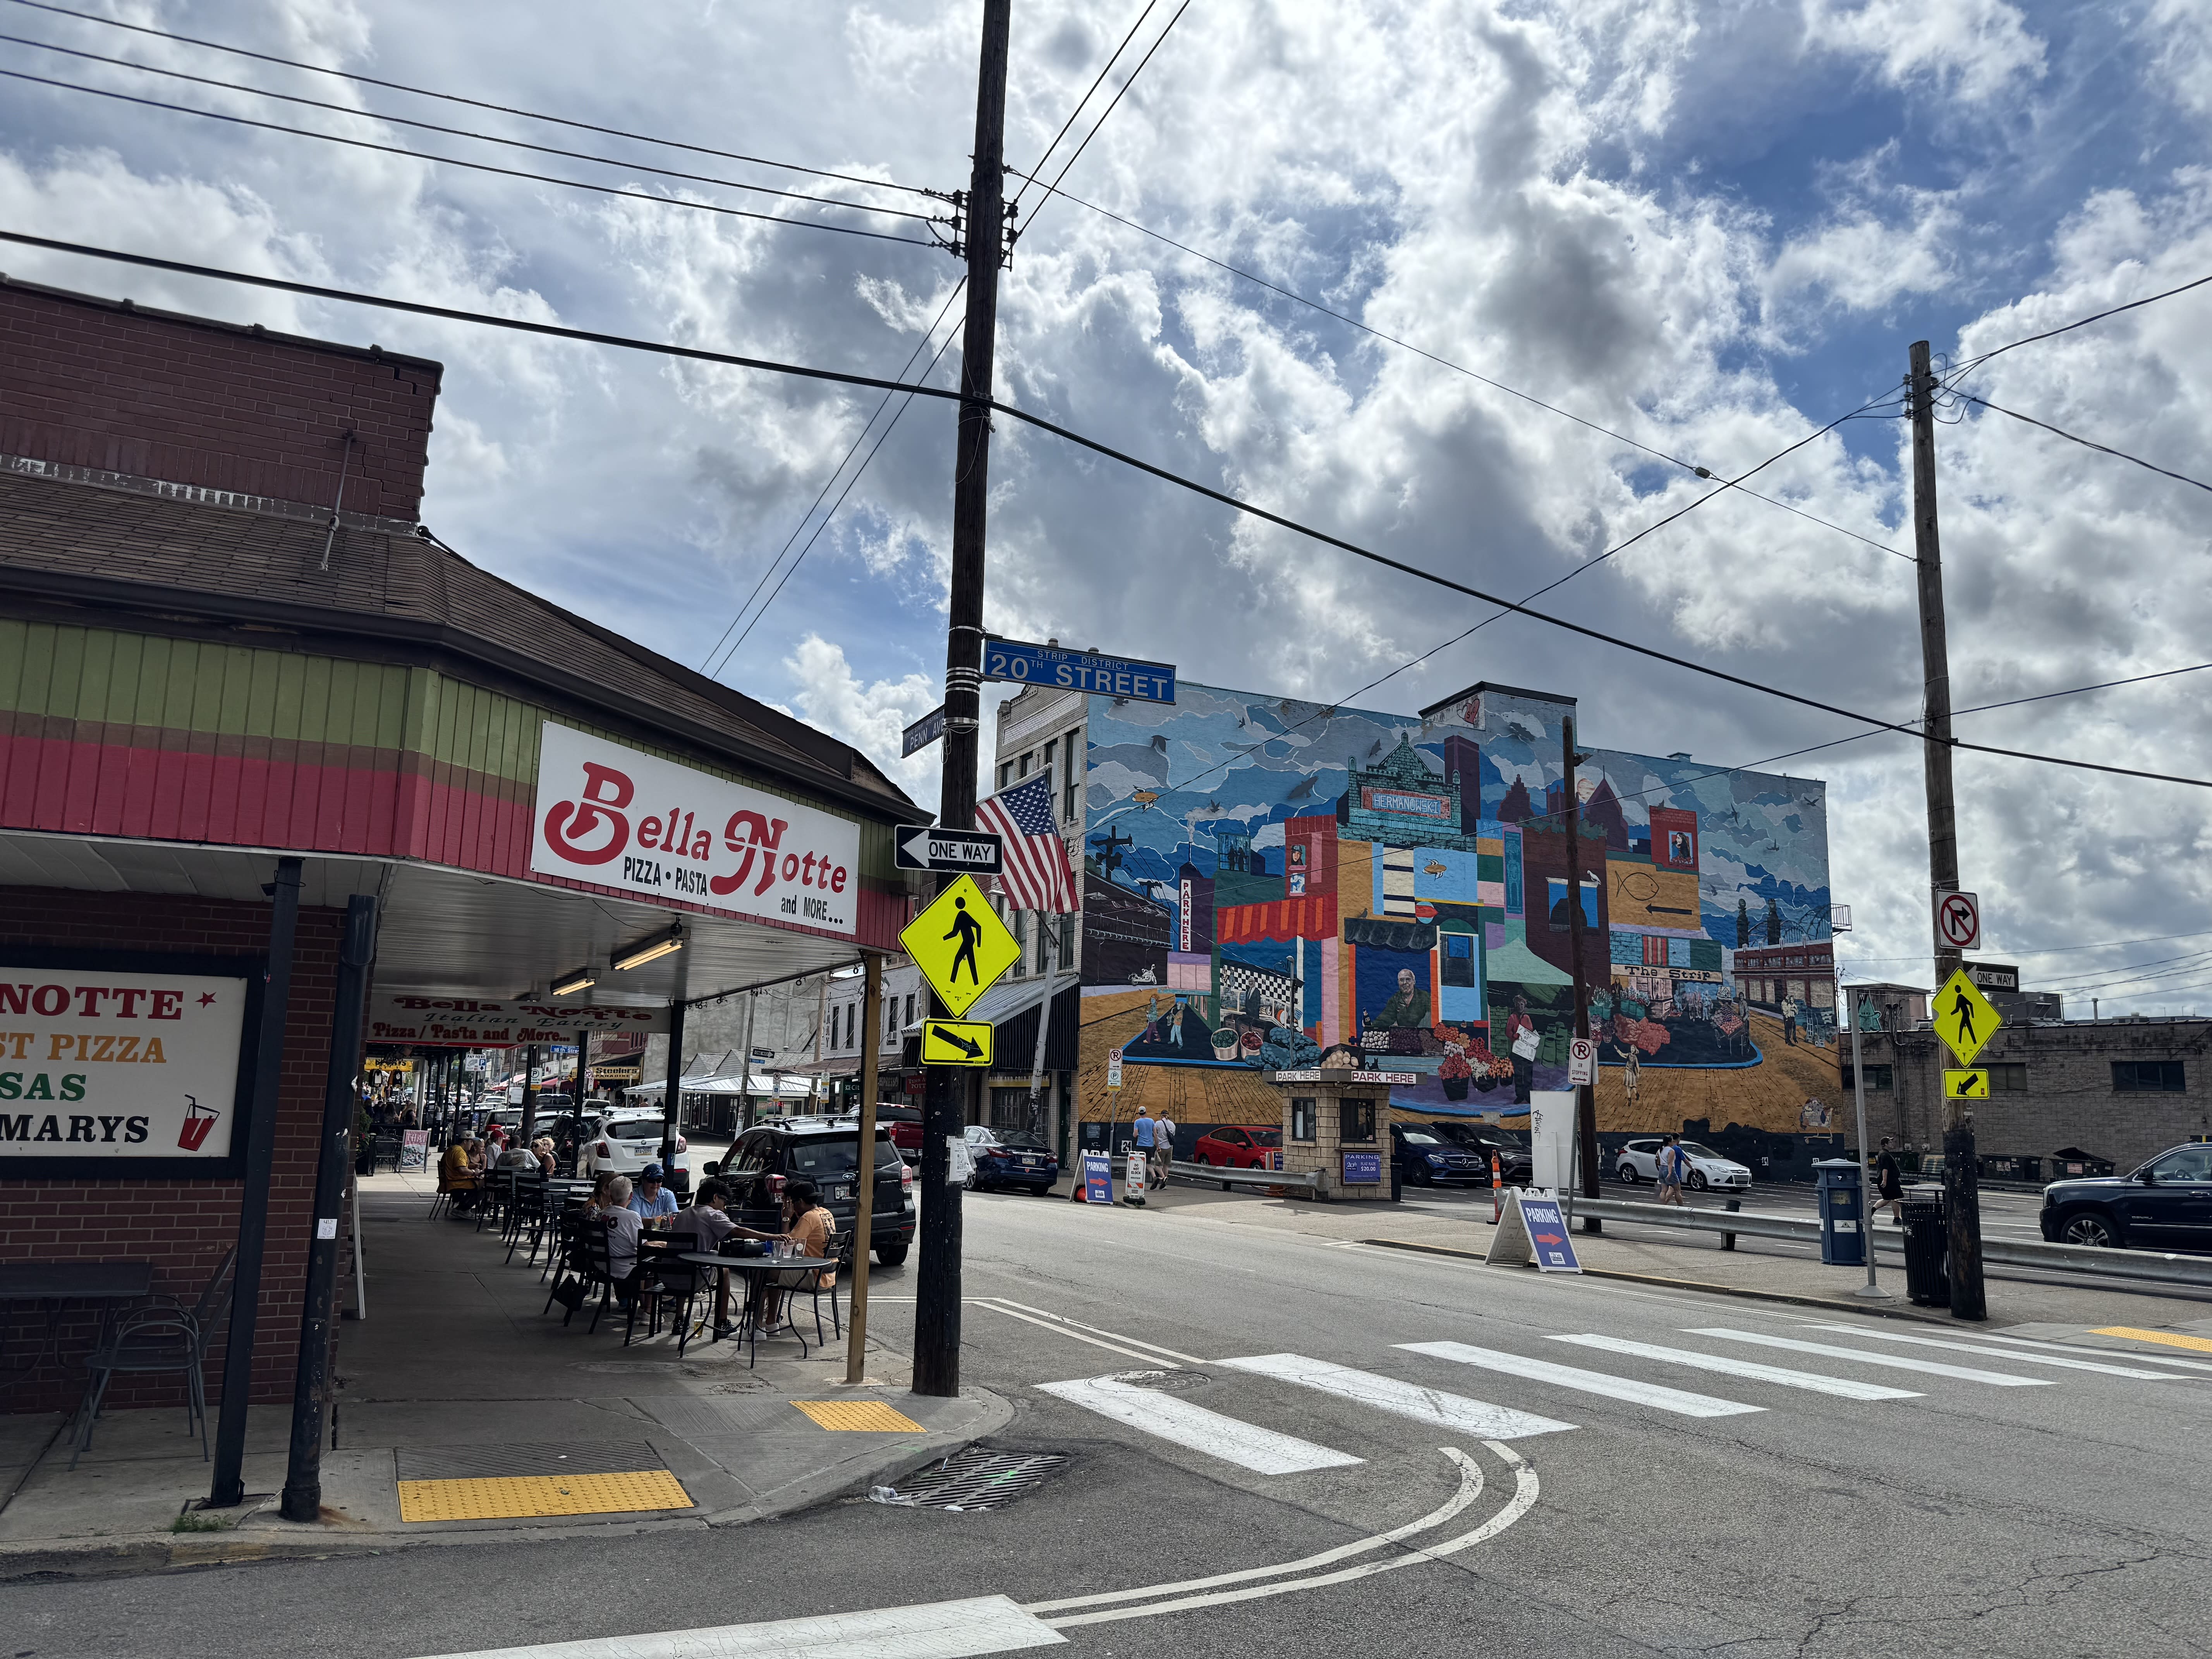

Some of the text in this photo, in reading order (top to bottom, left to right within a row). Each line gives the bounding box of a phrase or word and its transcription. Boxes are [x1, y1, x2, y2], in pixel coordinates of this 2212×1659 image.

[1037, 650, 1129, 671] STRIP DISTRICT
[991, 654, 1168, 699] 20TH STREET
[910, 728, 927, 750] PENN
[1374, 794, 1439, 814] HERMANOWSKI
[544, 761, 847, 896] Bella Notte
[929, 842, 991, 861] ONE WAY
[624, 856, 708, 896] PIZZA PASTA
[781, 895, 796, 914] and
[1625, 966, 1711, 981] The Strip
[1977, 972, 2012, 986] ONE WAY
[0, 984, 184, 1020] NOTTE
[393, 996, 652, 1020] Bella Notte
[423, 1013, 623, 1030] Italian Eatery
[373, 1022, 416, 1038] Pizza
[431, 1024, 478, 1040] Pasta
[483, 1028, 510, 1041] and
[517, 1027, 570, 1042] More...
[47, 1034, 167, 1063] PIZZA
[1278, 1071, 1320, 1081] PARK HERE
[1352, 1072, 1414, 1083] PARK HERE
[0, 1114, 149, 1143] MARYS
[407, 1133, 426, 1142] THAI
[1123, 1141, 1131, 1151] 24
[1087, 1161, 1109, 1173] PARKING
[1525, 1207, 1559, 1224] PARKING
